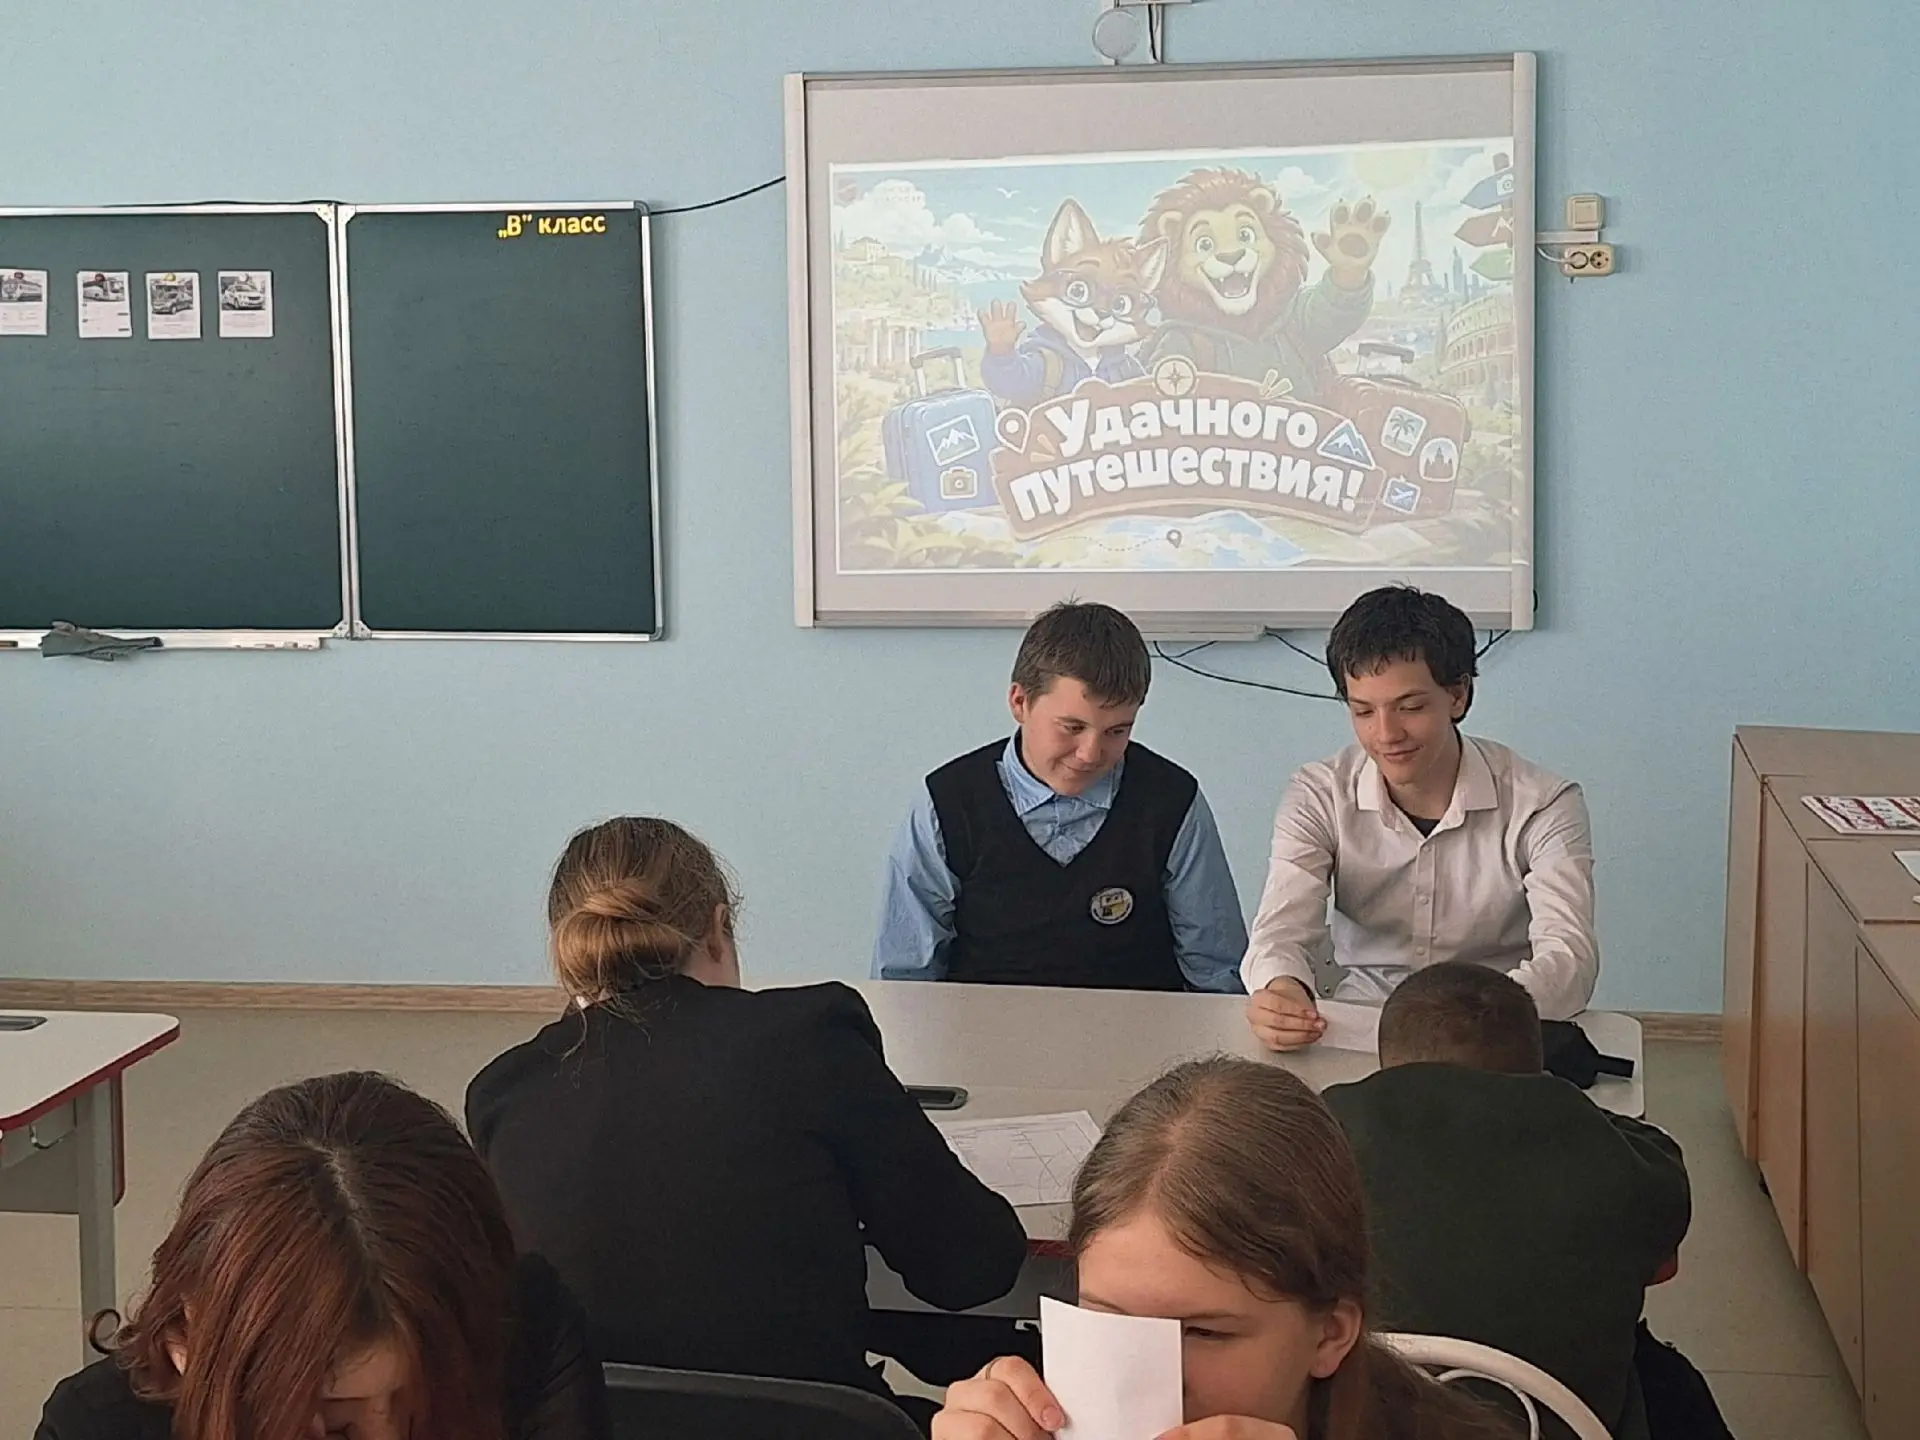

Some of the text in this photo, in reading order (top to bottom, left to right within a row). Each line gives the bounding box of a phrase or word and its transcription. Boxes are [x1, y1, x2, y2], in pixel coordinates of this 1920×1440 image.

[538, 216, 606, 234] класс
[1046, 398, 1318, 457] Удачного
[1009, 447, 1364, 521] путешествия!
